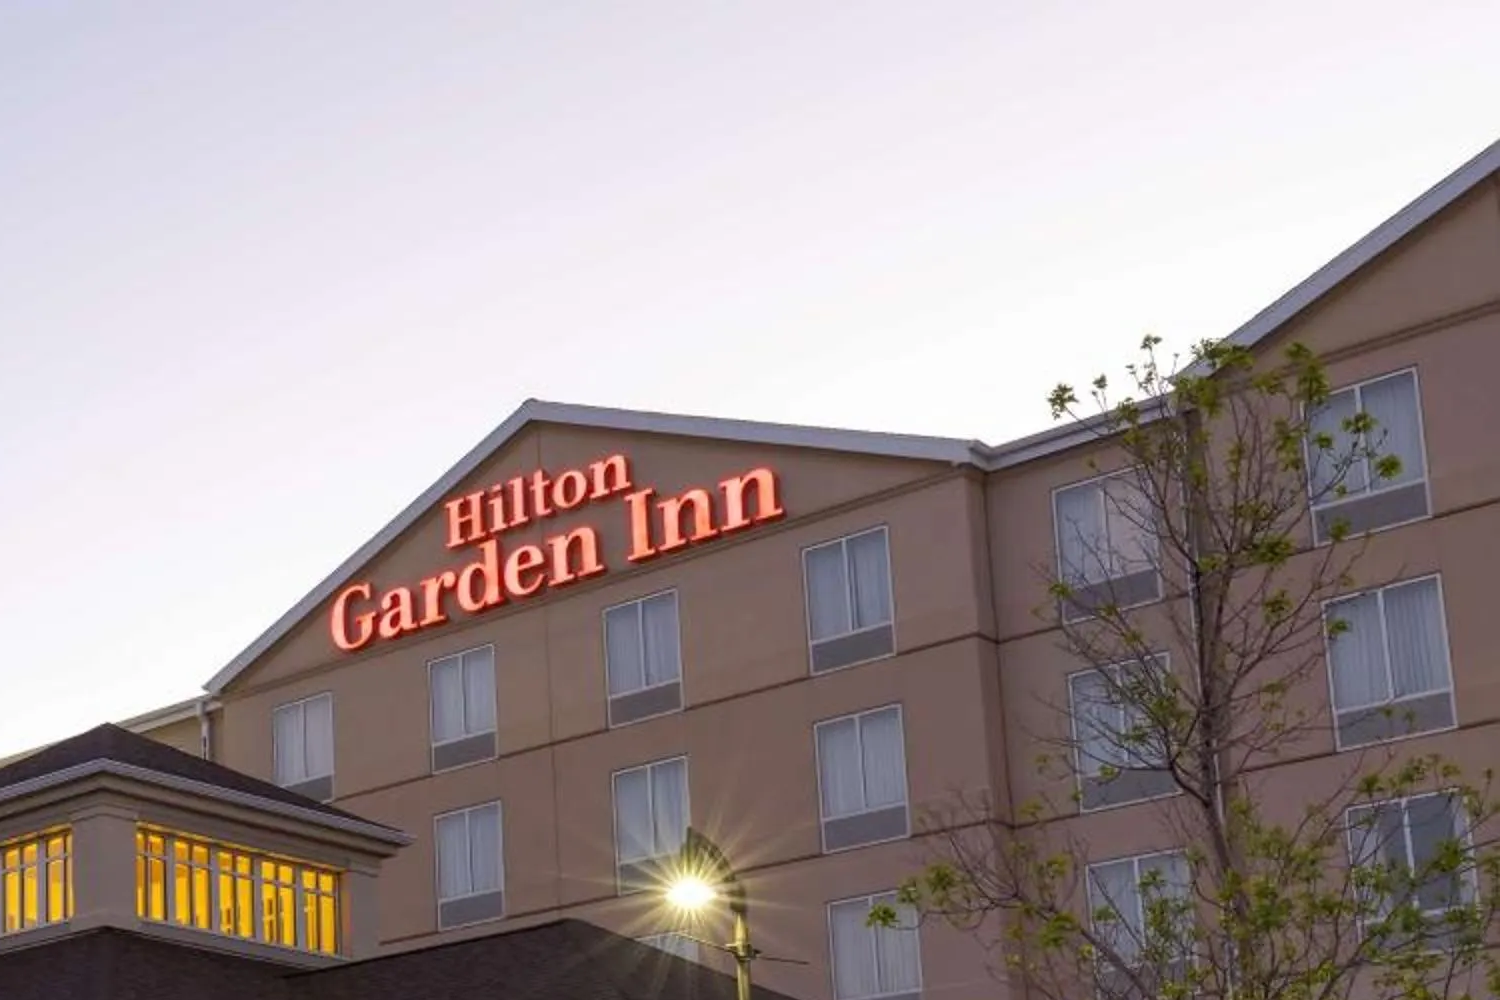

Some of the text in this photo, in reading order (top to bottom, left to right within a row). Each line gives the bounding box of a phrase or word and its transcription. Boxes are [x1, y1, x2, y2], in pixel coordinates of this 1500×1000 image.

[329, 464, 785, 652] Garden Inn
[444, 452, 633, 549] Hilton
